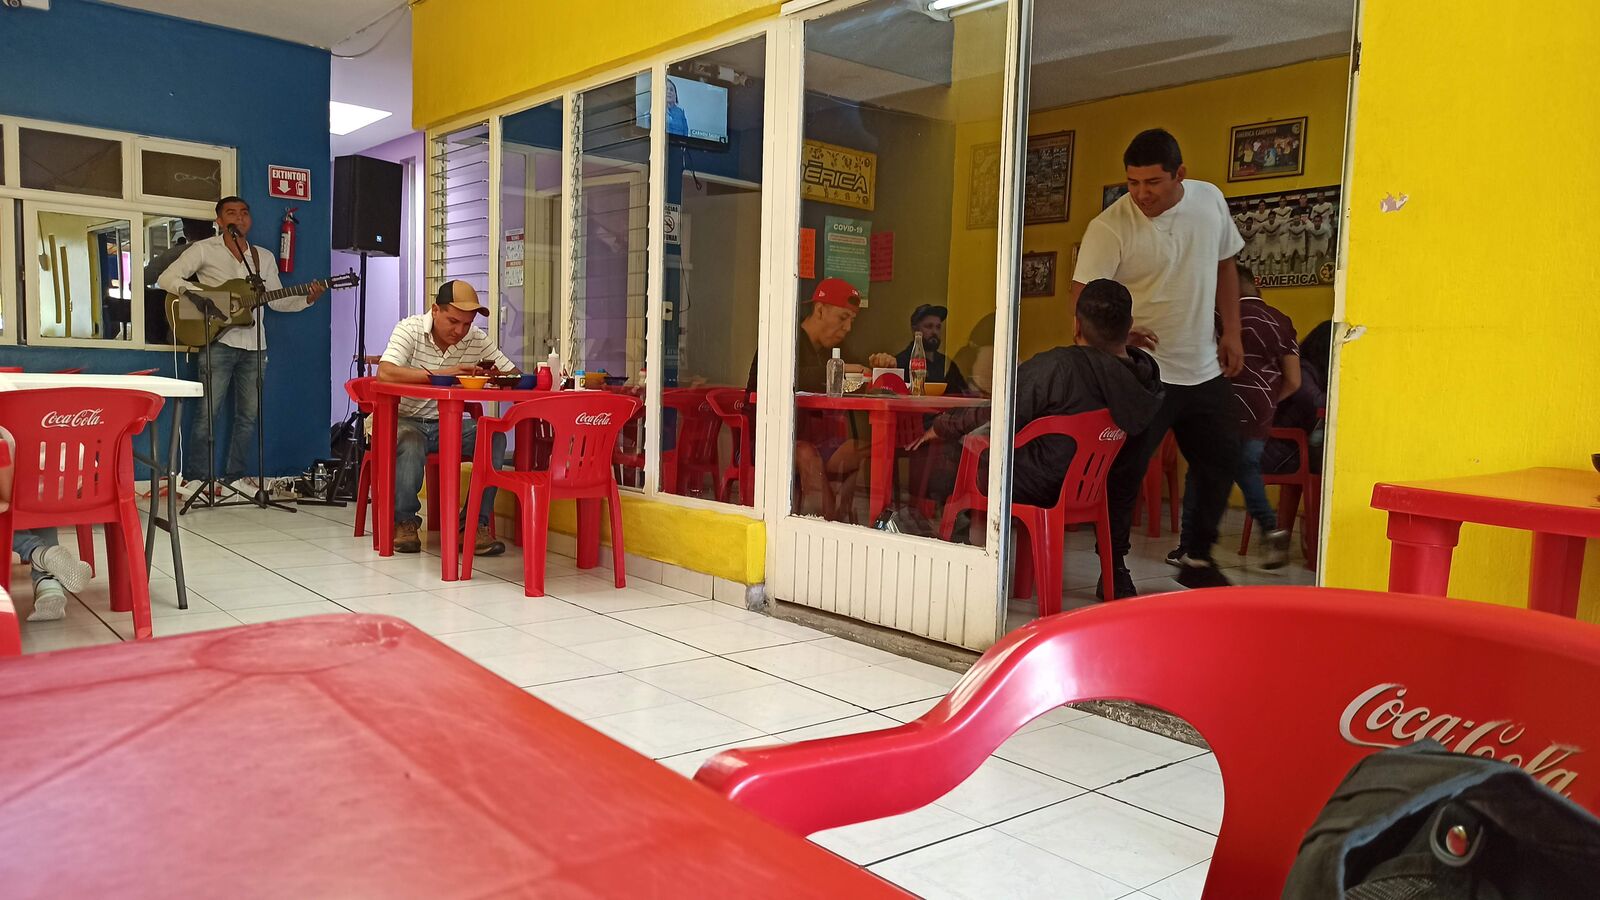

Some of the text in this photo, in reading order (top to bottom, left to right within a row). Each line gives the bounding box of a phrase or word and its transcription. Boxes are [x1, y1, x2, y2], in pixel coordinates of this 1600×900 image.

[272, 169, 307, 182] EXTINTOR
[833, 223, 863, 234] COVID-19
[41, 408, 104, 428] Coca-Cola
[575, 411, 613, 426] Coca-Cola
